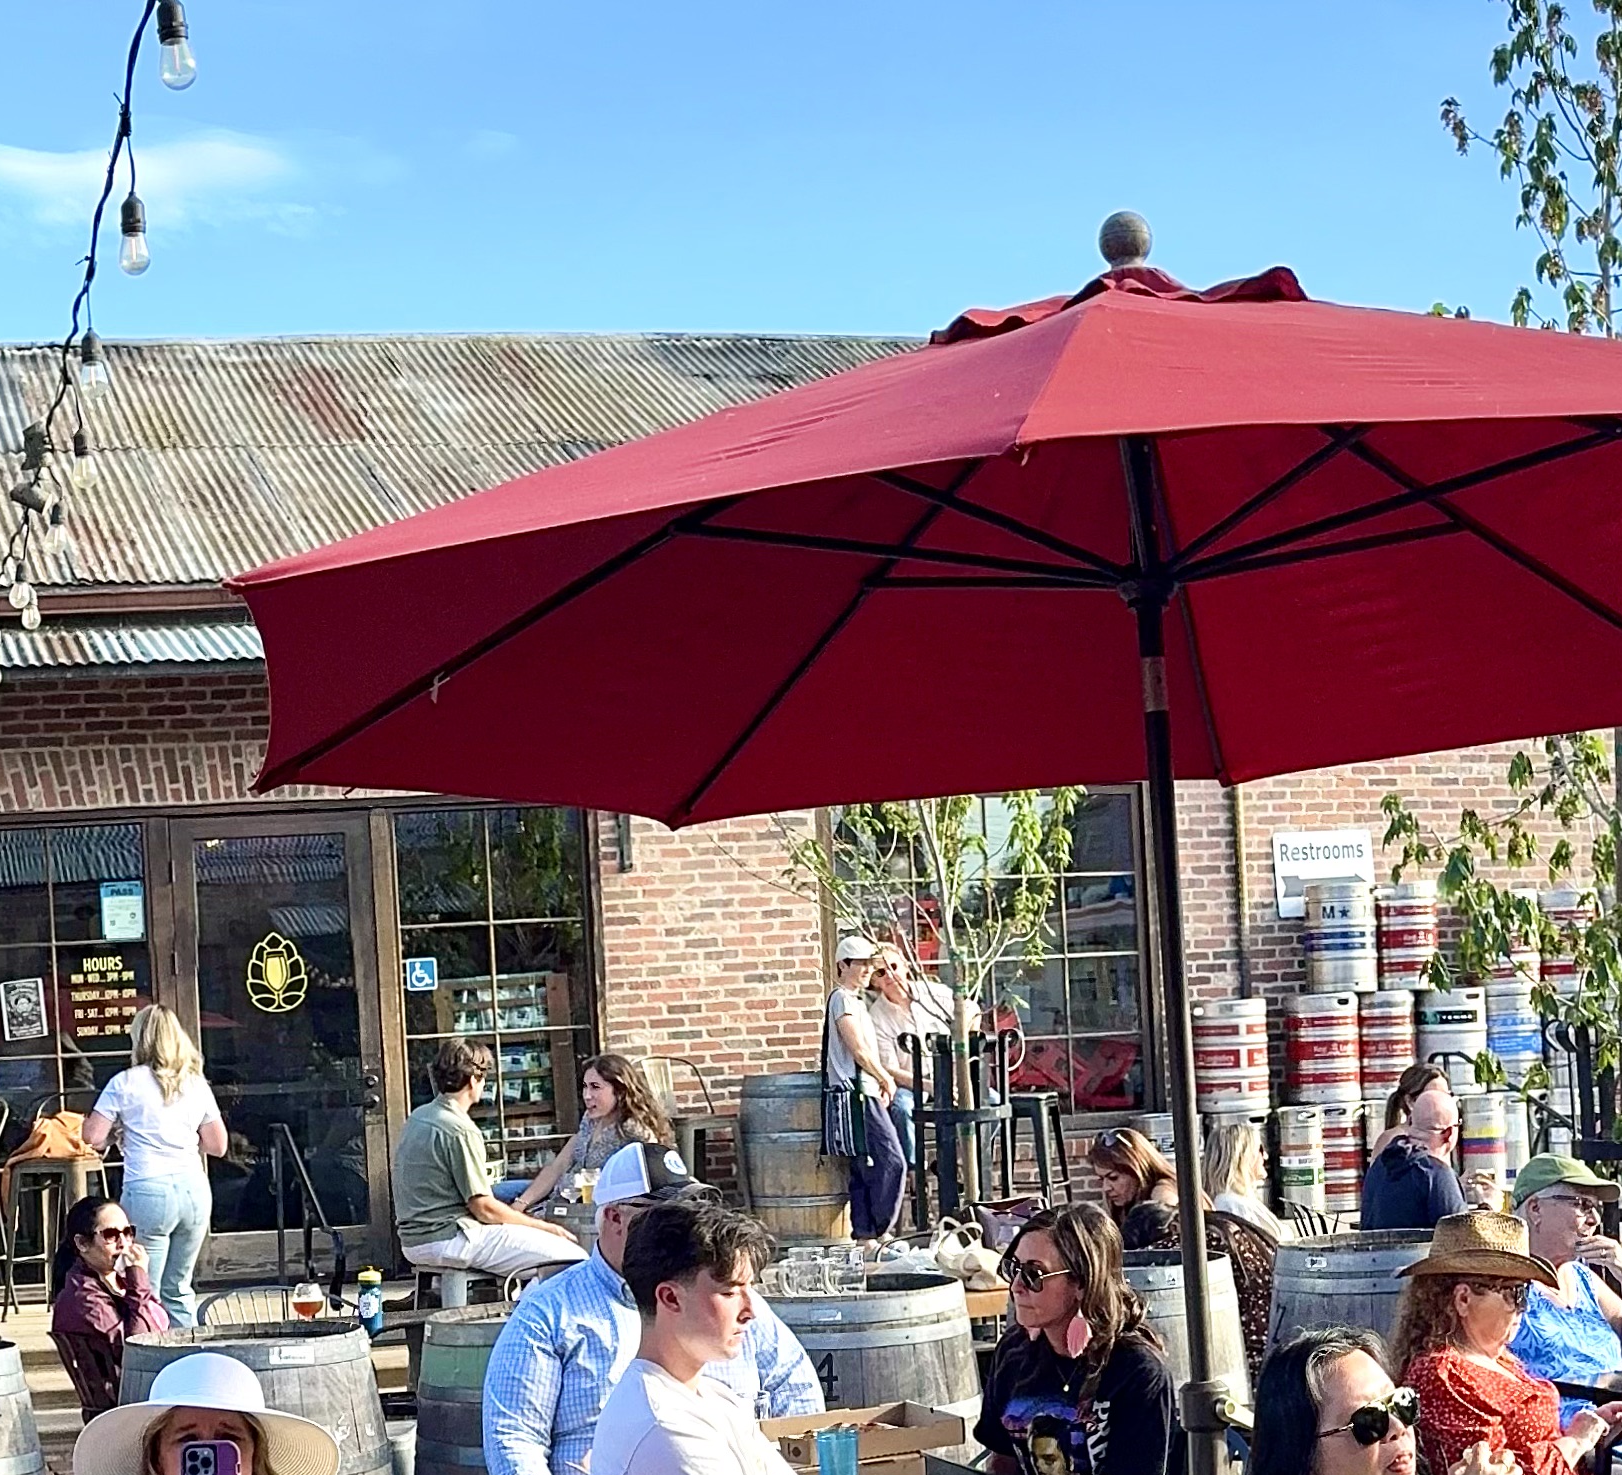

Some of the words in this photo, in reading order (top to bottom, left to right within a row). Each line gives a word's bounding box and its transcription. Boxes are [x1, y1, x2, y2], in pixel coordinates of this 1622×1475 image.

[1279, 842, 1364, 862] Restrooms
[110, 887, 135, 897] PASS
[82, 955, 124, 972] HOURS
[817, 1352, 840, 1403] 4
